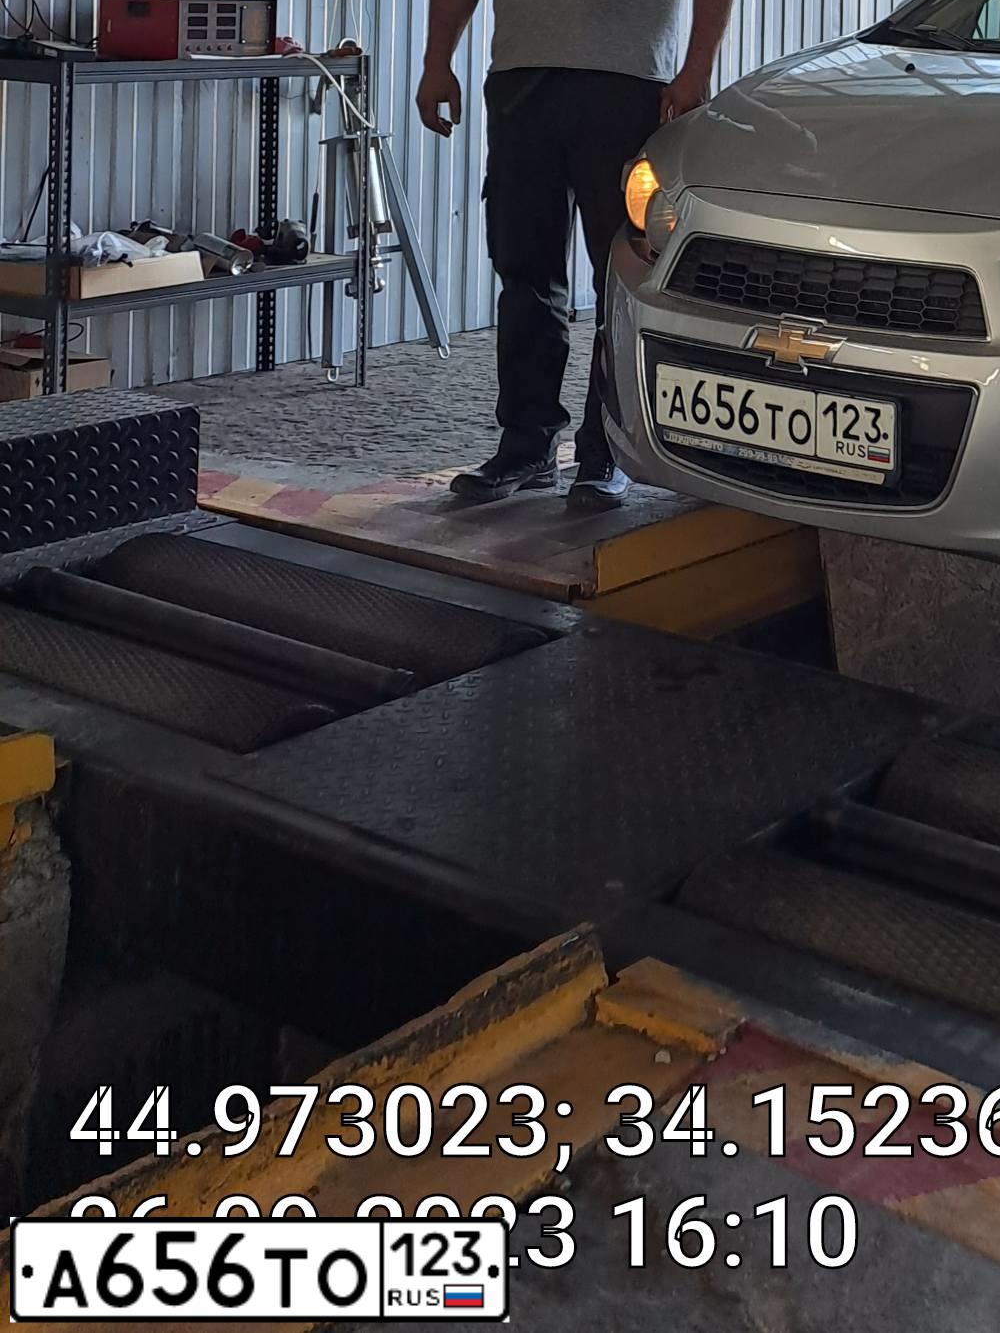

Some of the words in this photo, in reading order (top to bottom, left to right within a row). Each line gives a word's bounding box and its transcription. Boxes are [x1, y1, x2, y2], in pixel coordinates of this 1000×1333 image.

[668, 380, 812, 445] А656ТО
[822, 401, 882, 443] 123
[835, 441, 867, 459] RUS
